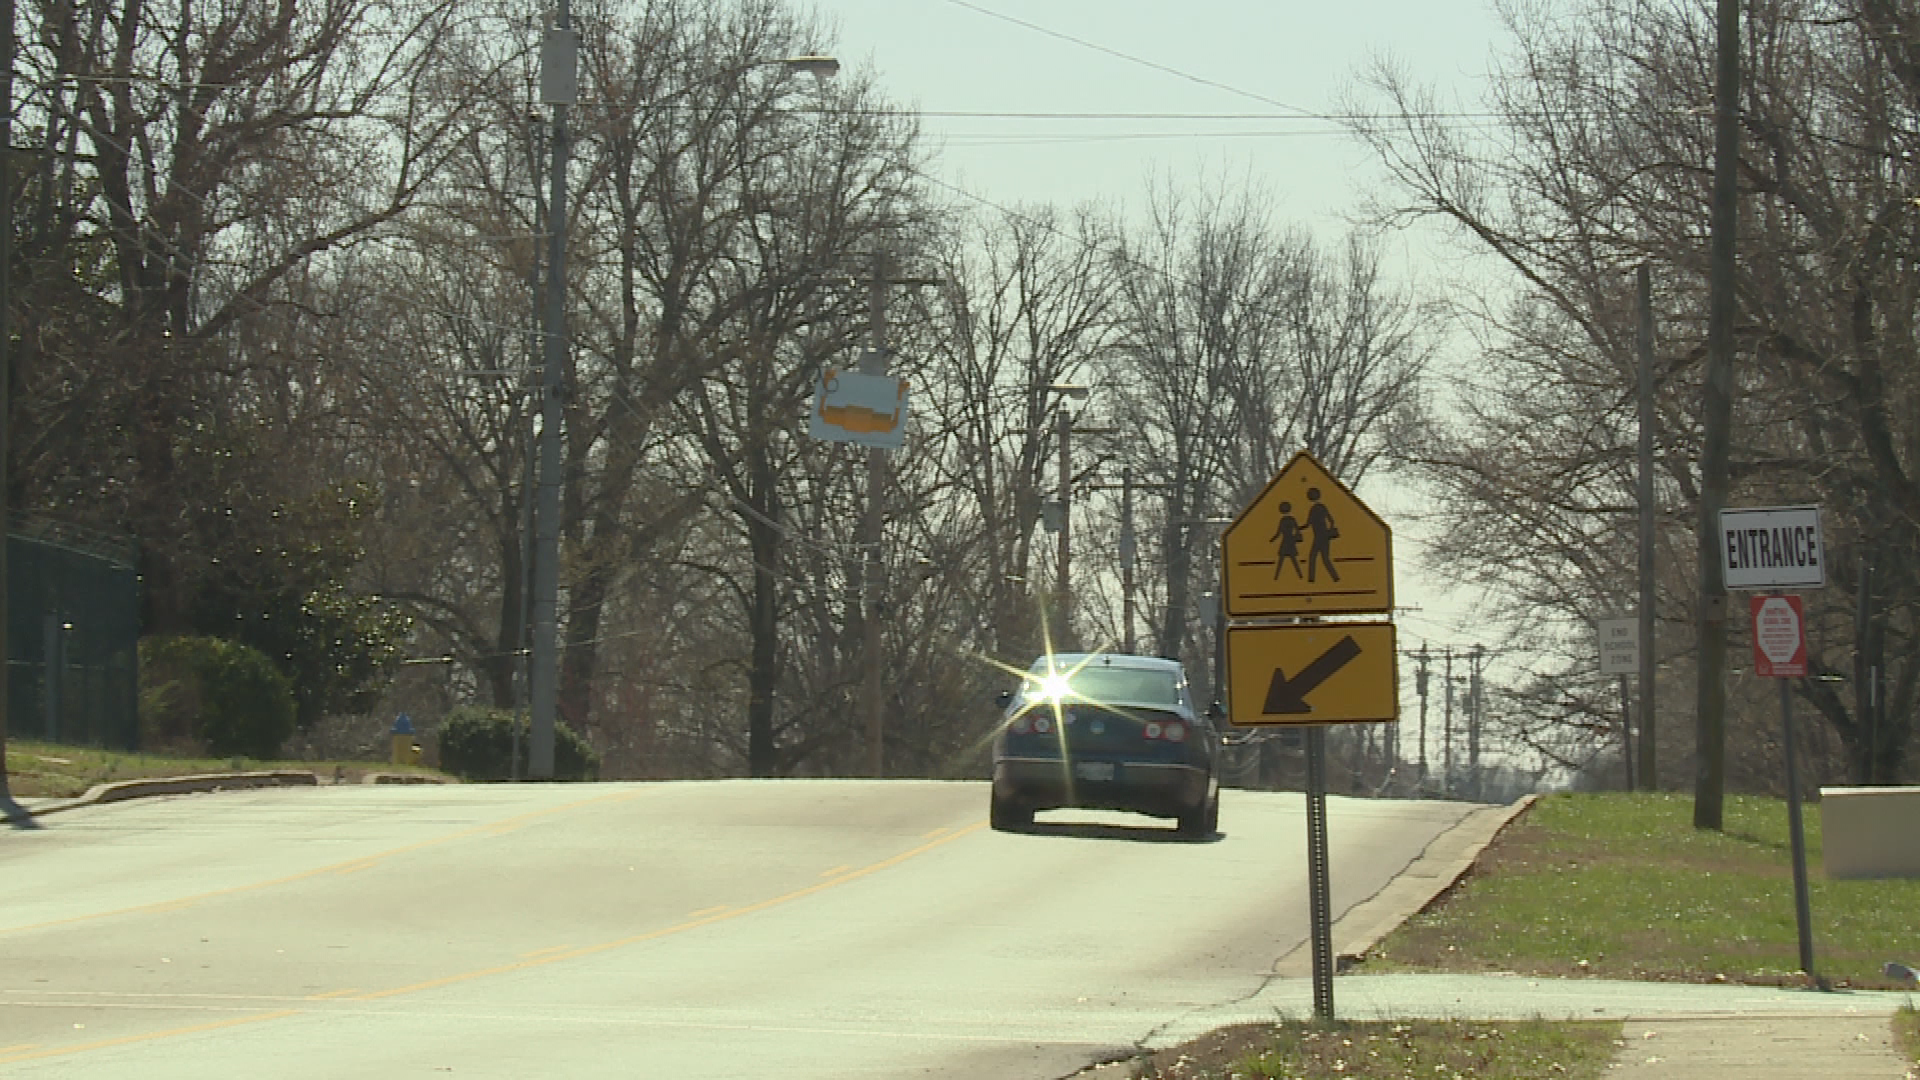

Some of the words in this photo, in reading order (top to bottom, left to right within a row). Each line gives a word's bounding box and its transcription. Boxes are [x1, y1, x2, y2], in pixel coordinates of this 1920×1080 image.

[1726, 525, 1817, 569] ENTRANCE
[1611, 627, 1628, 637] END
[1604, 640, 1637, 651] SCHOOL
[1611, 654, 1632, 665] ZONE
